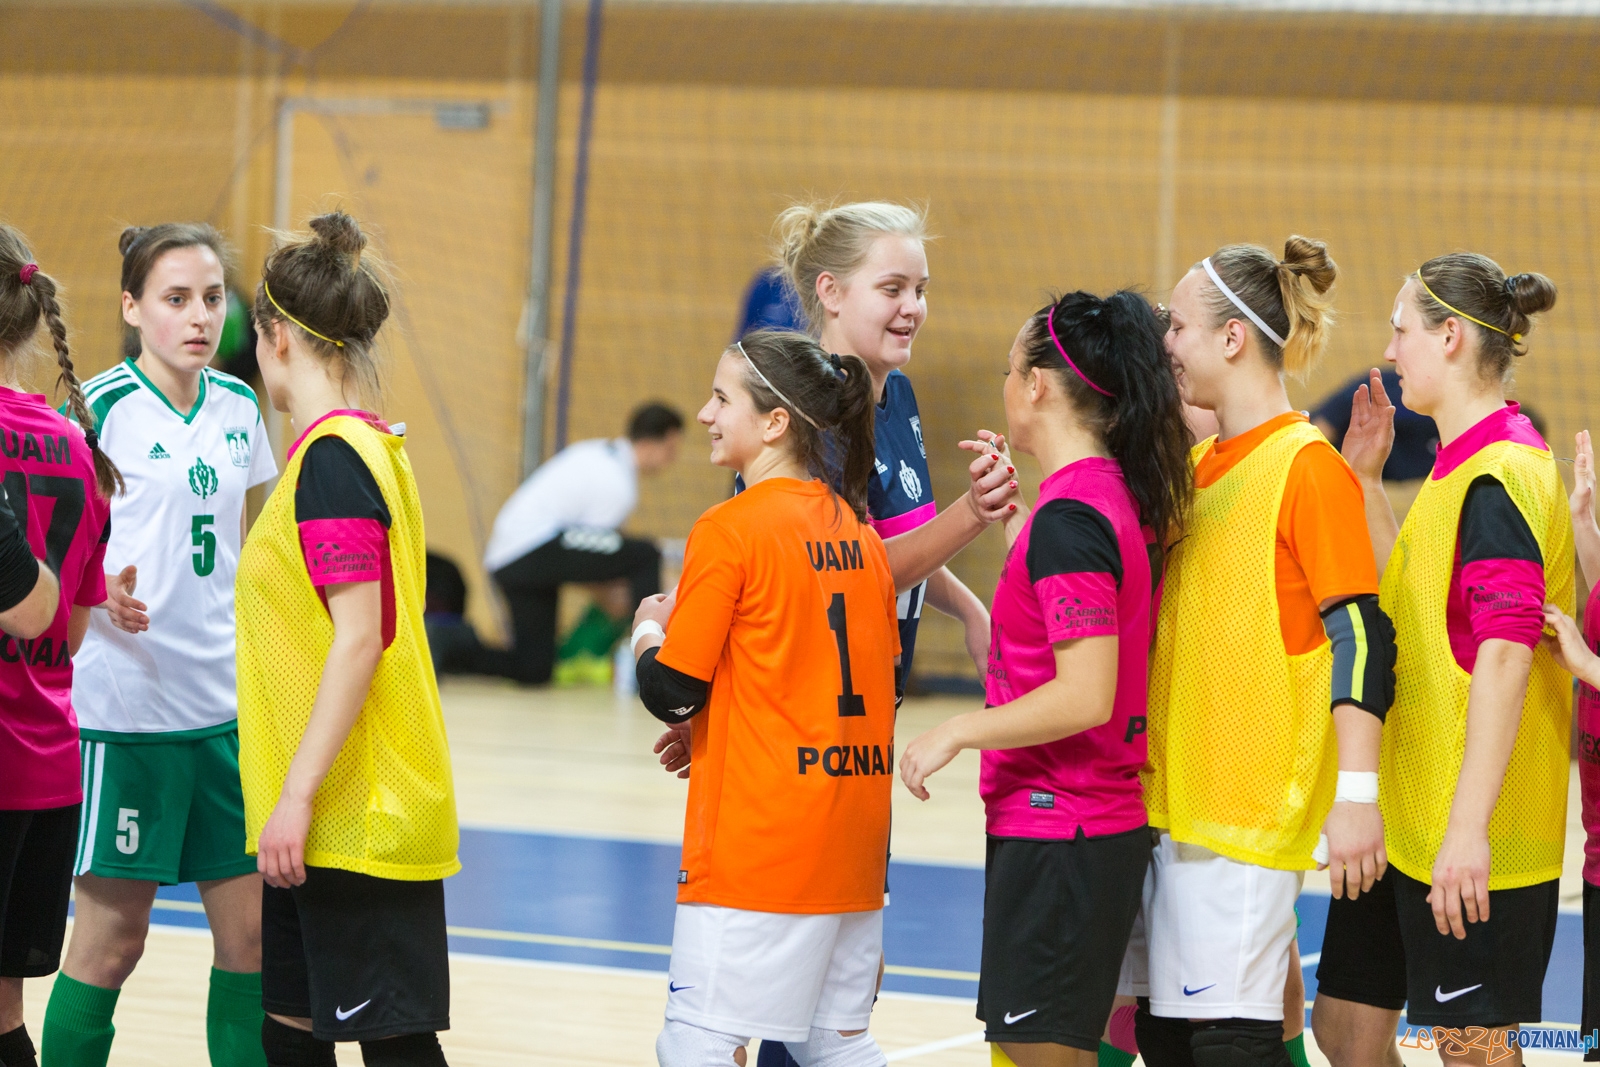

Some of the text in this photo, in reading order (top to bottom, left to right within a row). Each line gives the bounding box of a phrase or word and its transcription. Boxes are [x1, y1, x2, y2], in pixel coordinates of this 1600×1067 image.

[0, 428, 72, 465] UAM
[191, 514, 217, 578] 5
[806, 539, 864, 572] UAM
[827, 592, 867, 717] 1
[115, 807, 140, 855] 5
